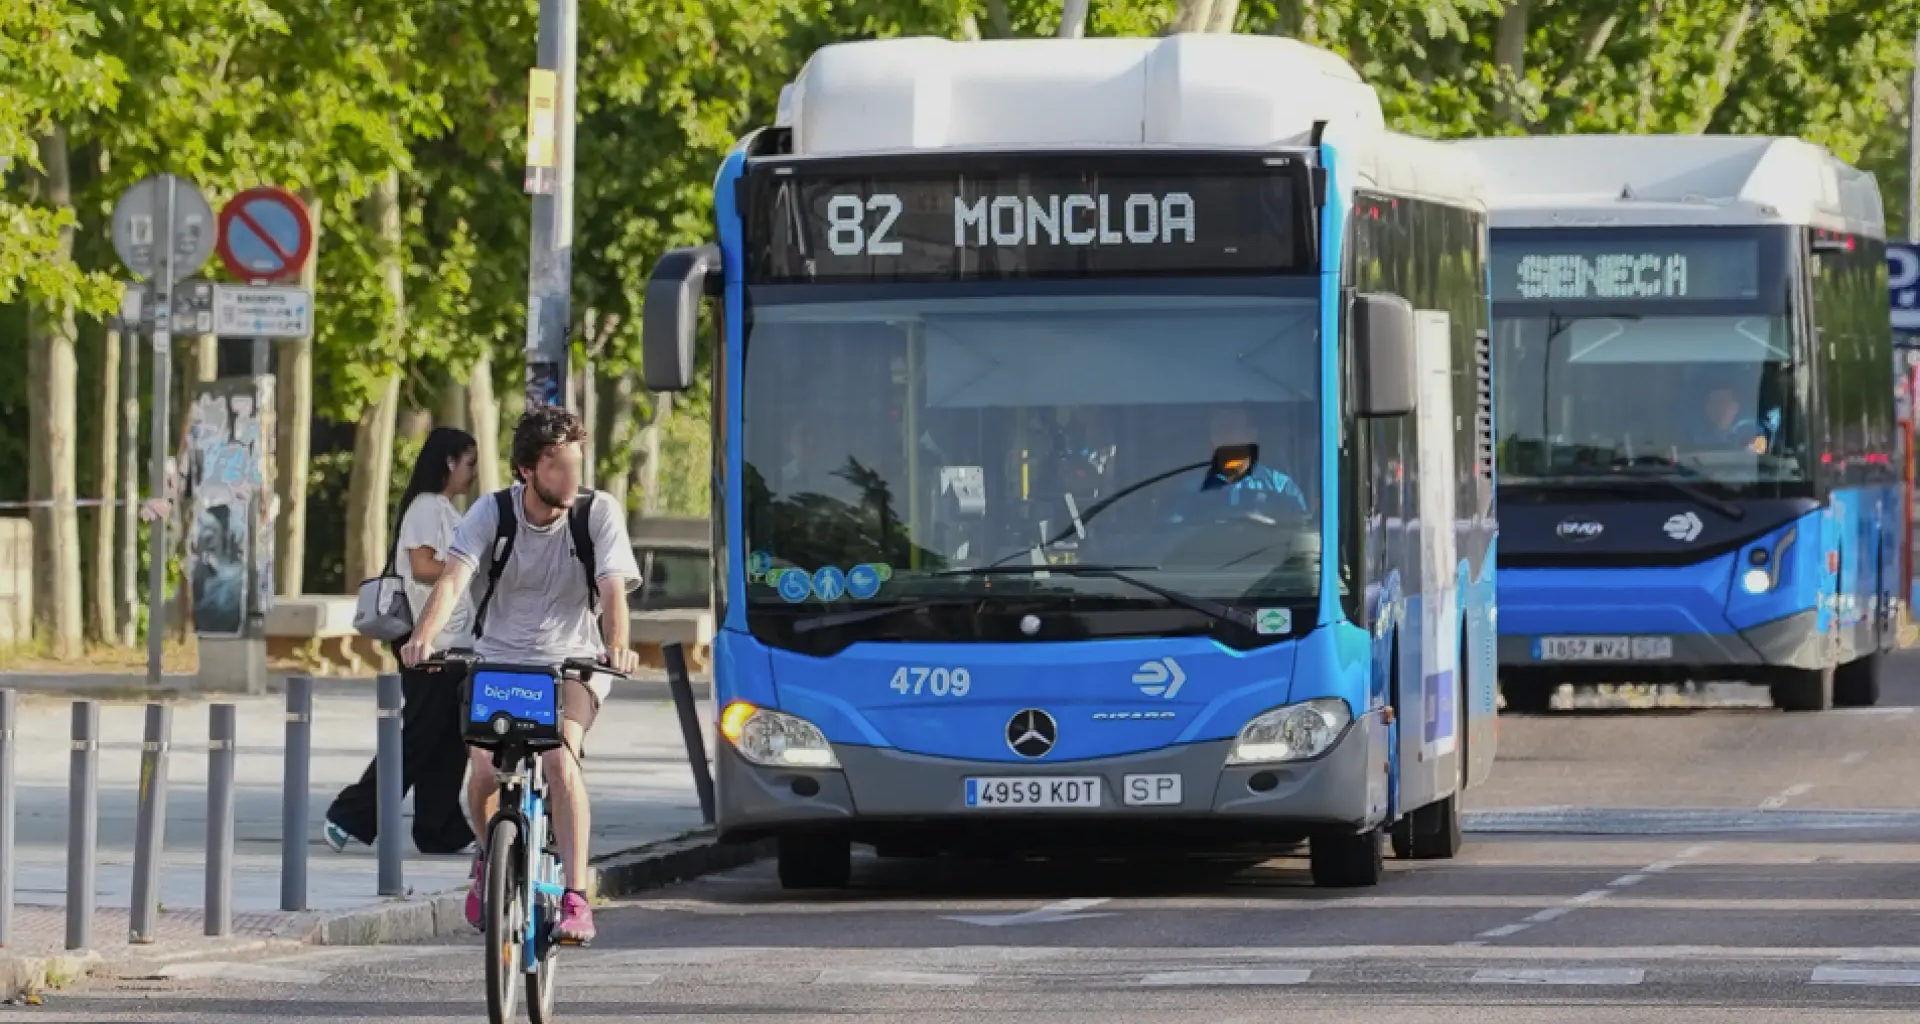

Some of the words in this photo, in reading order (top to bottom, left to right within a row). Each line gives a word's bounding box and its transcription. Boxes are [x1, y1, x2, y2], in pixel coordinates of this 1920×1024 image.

[827, 194, 903, 255] 82
[954, 192, 1195, 247] MONCLOA
[1516, 253, 1687, 298] SENECA
[890, 667, 970, 697] 4709
[982, 781, 1042, 804] 4959
[1050, 780, 1095, 803] KDT
[1131, 777, 1174, 801] SP
